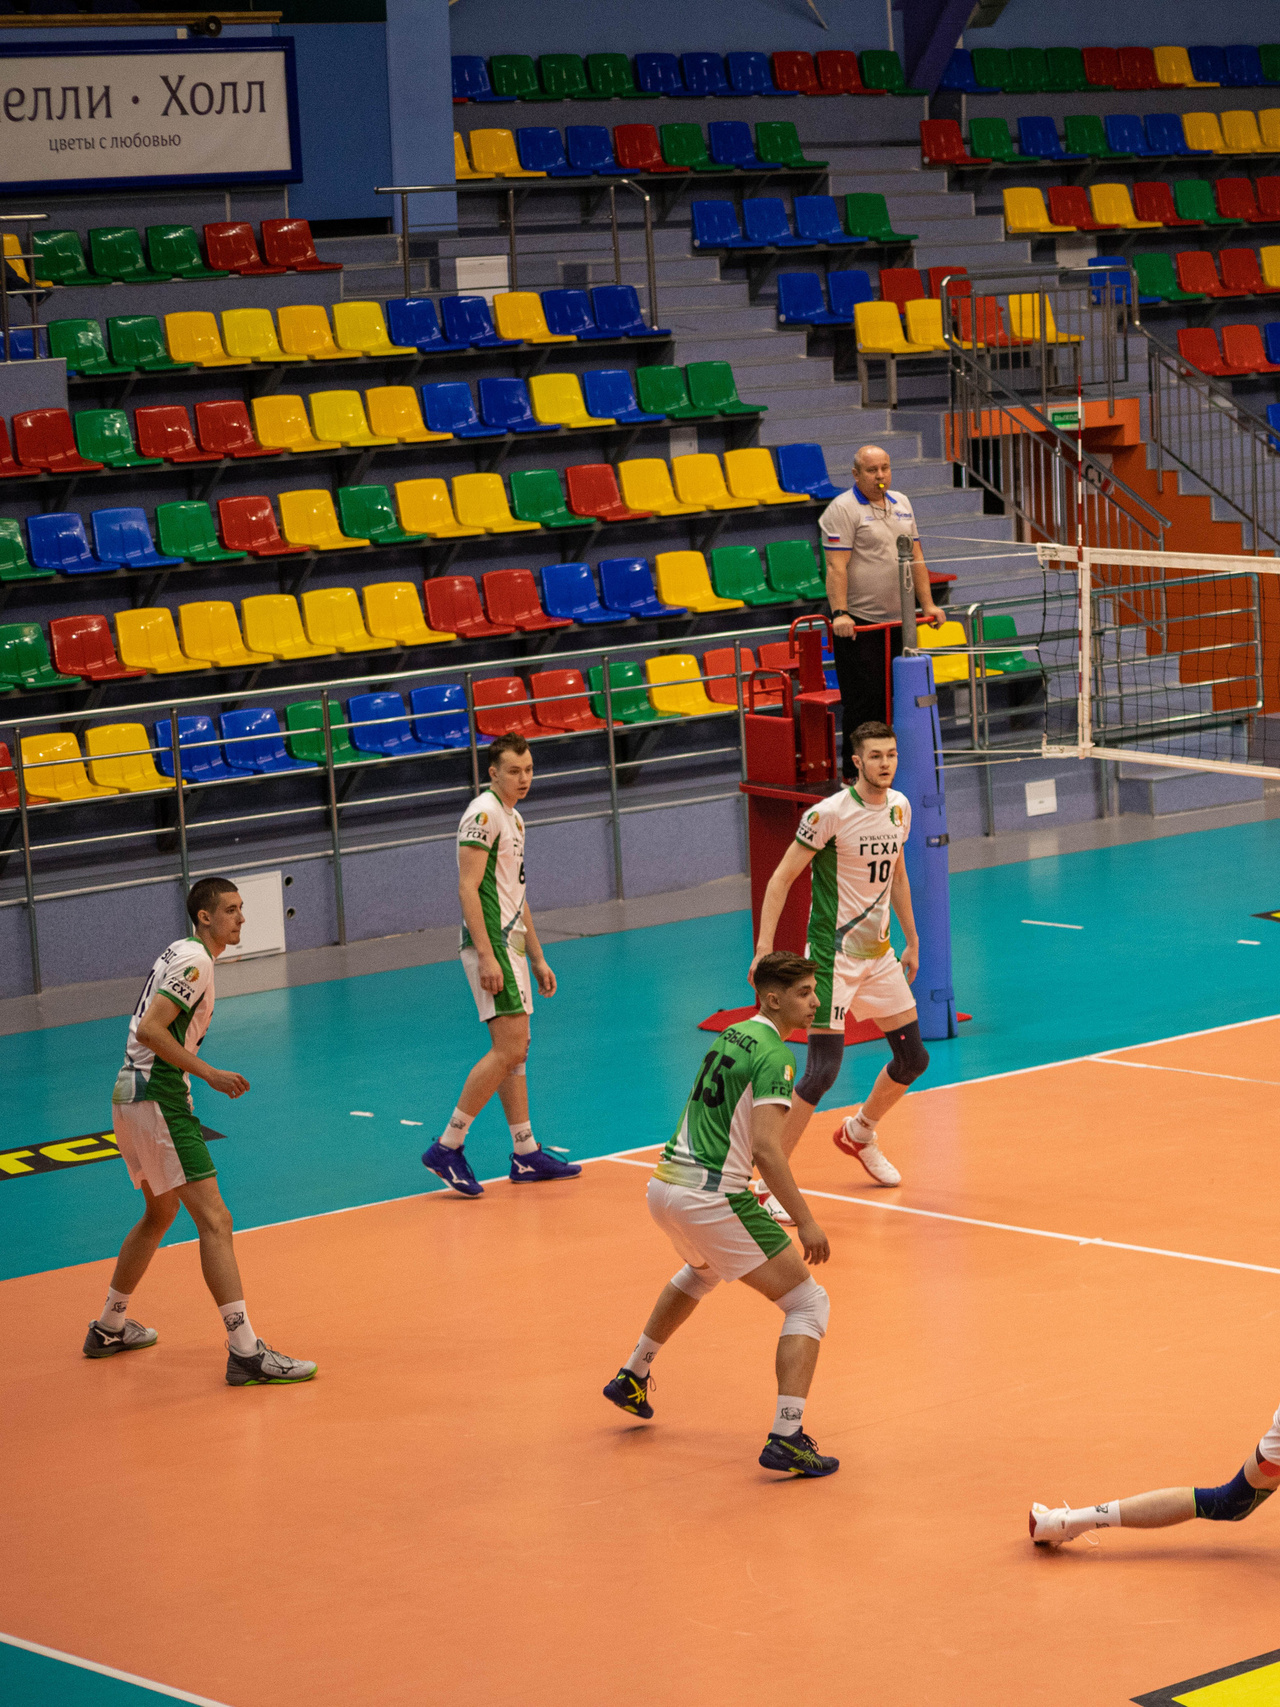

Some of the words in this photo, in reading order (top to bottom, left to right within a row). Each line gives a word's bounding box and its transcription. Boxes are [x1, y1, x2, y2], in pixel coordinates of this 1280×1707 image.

[0, 84, 113, 122] елли
[160, 74, 267, 117] Холл
[48, 136, 95, 153] цветы
[98, 137, 107, 150] с
[110, 131, 182, 150] любовью
[859, 841, 899, 856] ГСХА
[867, 859, 891, 883] 10
[691, 1050, 736, 1109] 15
